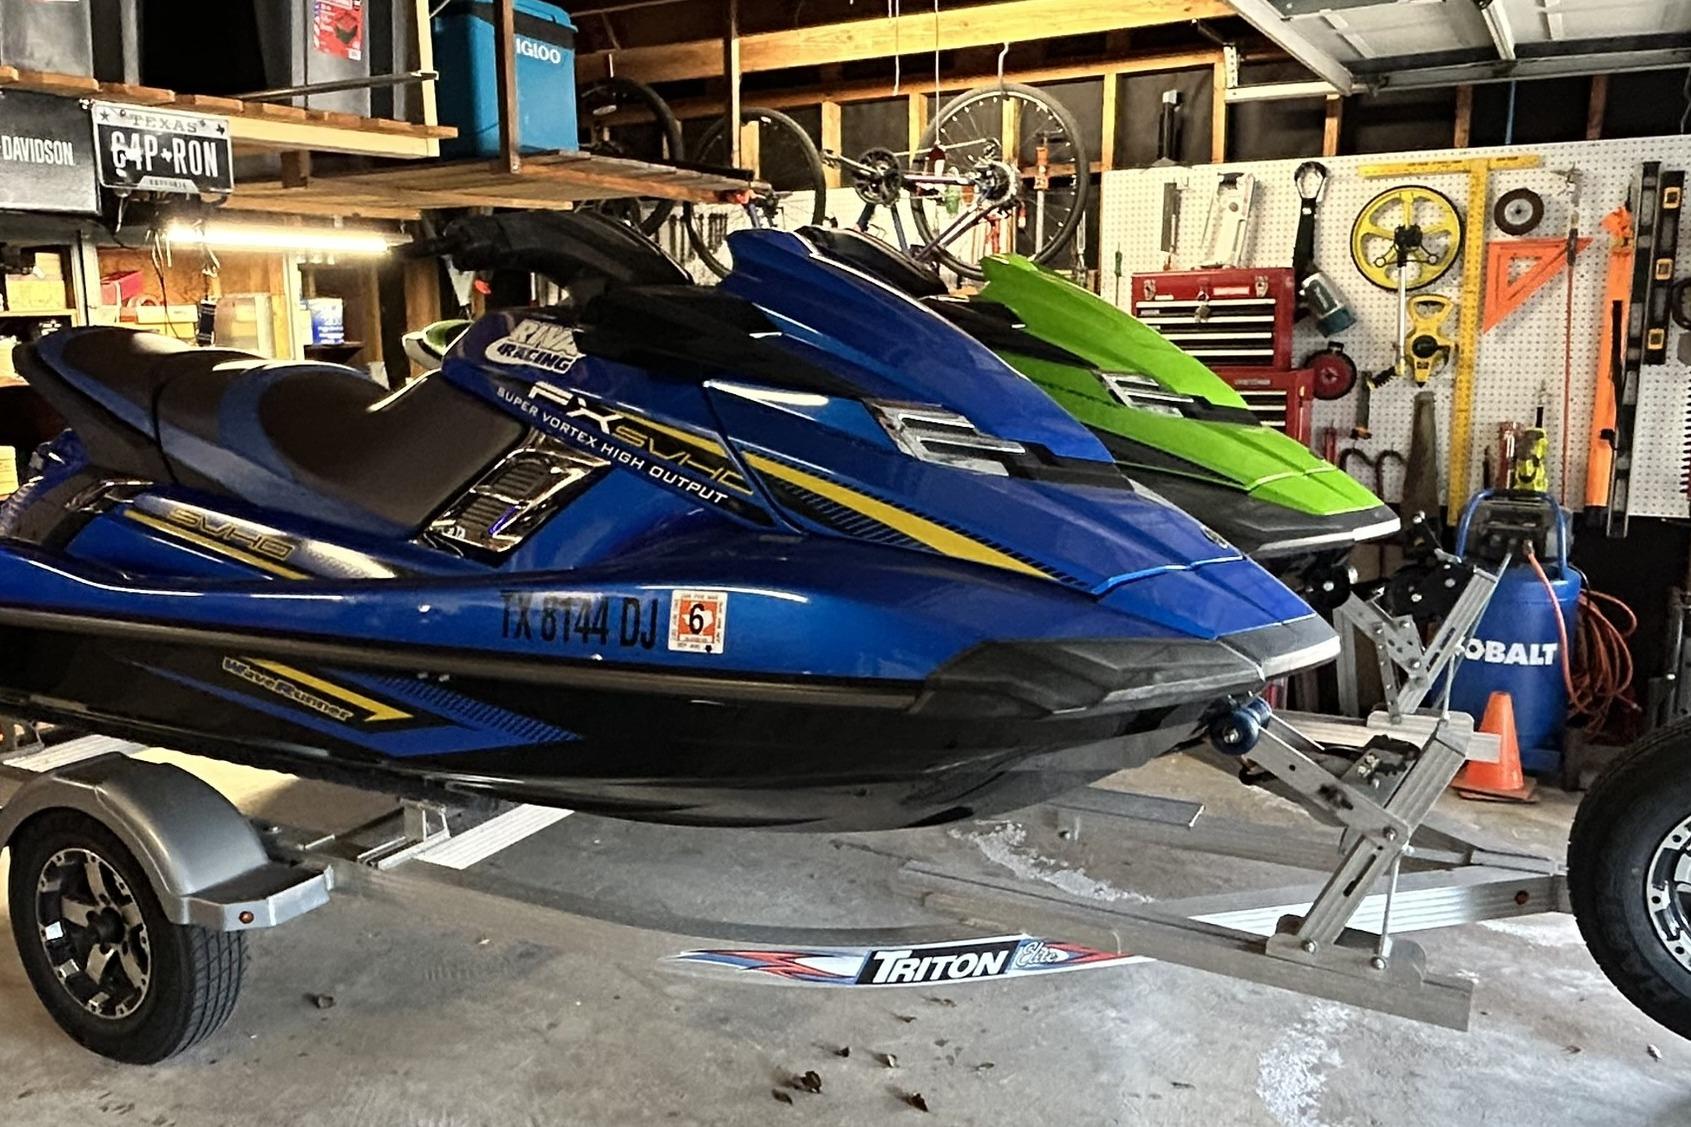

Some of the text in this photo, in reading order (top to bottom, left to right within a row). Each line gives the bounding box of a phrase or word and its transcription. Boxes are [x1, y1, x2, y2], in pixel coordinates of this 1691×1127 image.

[515, 38, 561, 64] IGLOO
[130, 114, 198, 134] TEXAS
[172, 137, 218, 178] RON
[497, 342, 574, 371] RACING
[528, 381, 623, 434] FX
[497, 386, 728, 503] SUPER VORTEX HIGH OUTPUT
[501, 591, 532, 640] TX
[620, 596, 659, 651] DJ
[689, 603, 705, 635] 6
[1457, 637, 1558, 665] OBALT
[872, 941, 1058, 984] TRITON Elite
